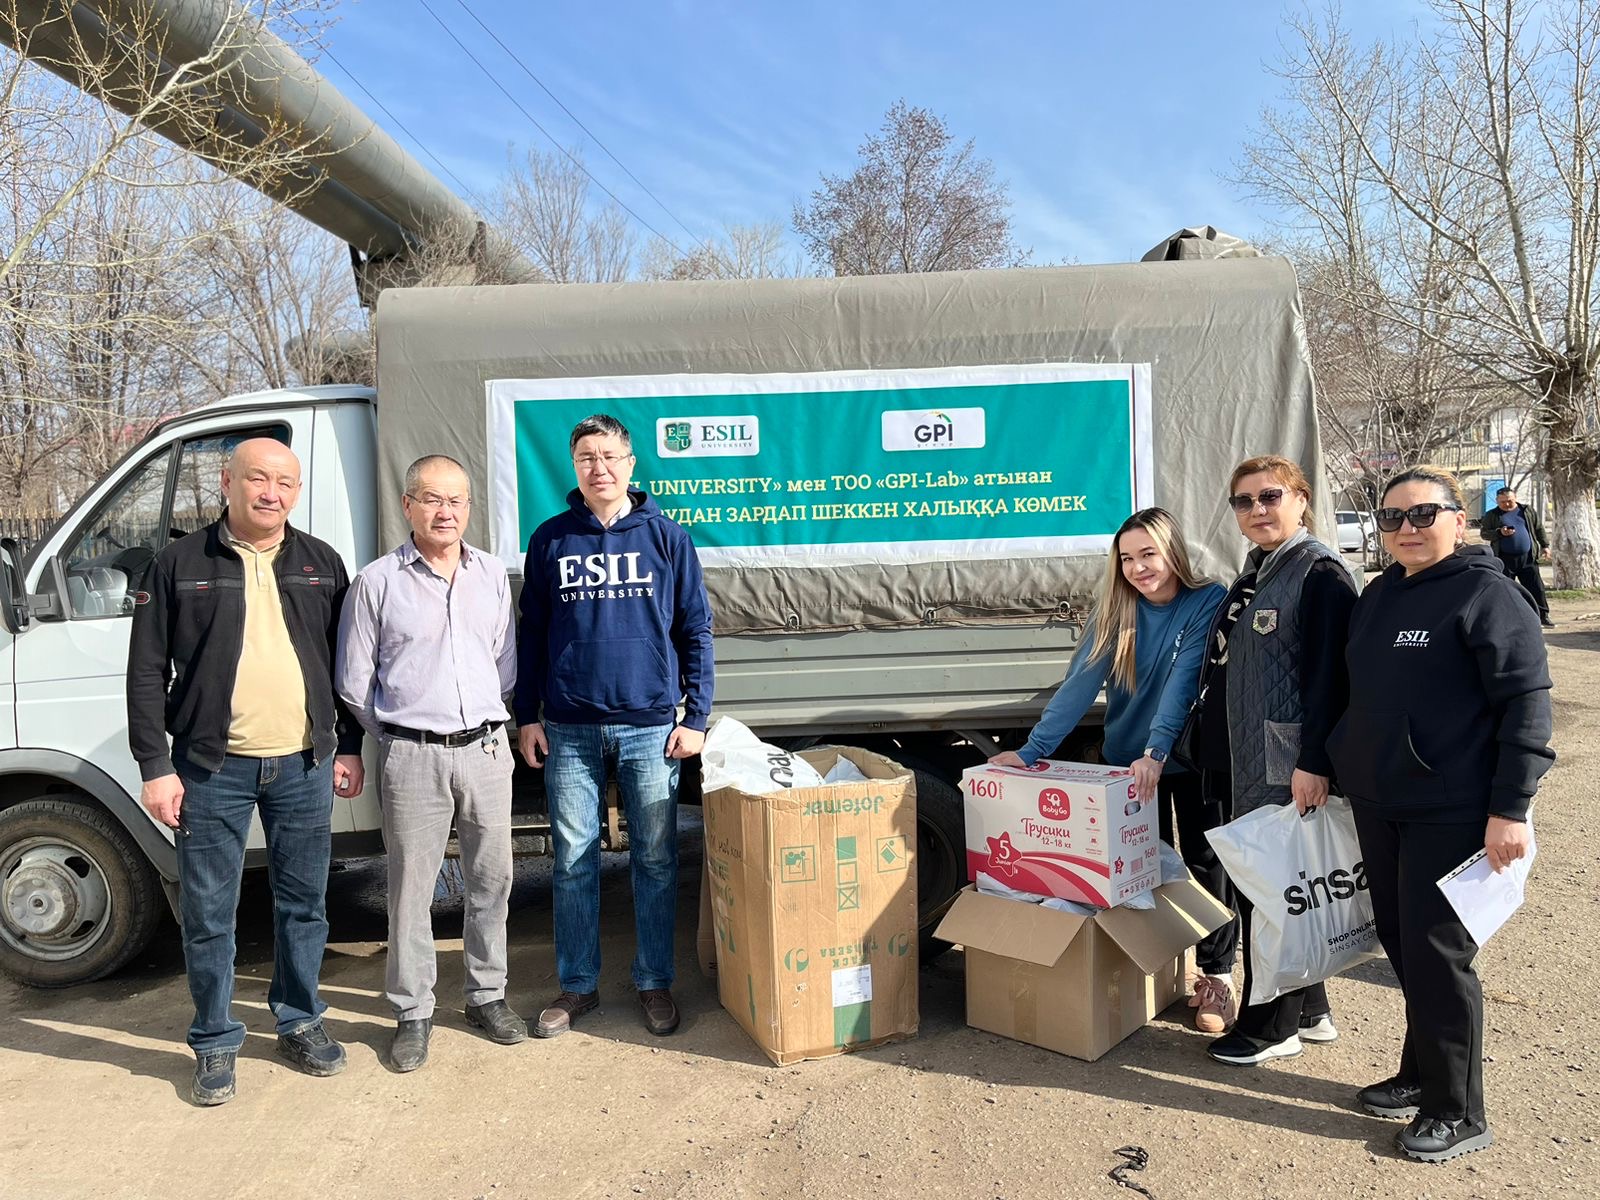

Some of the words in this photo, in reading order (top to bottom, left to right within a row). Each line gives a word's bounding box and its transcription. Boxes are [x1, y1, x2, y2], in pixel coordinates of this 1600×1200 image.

[701, 424, 752, 441] ESIL
[914, 424, 953, 443] GPI
[650, 478, 782, 496] UNIVERSITY»
[787, 478, 827, 492] мен
[831, 474, 872, 490] ТОО
[876, 471, 969, 489] «GPI-Lab»
[973, 471, 1053, 486] атынан
[660, 507, 722, 527] УДАН
[726, 504, 807, 525] ЗАРДАП
[812, 502, 899, 521] ШЕККЕН
[903, 498, 1009, 518] ХАЛЫҚҚА
[1013, 495, 1088, 513] КӨМЕК
[557, 552, 653, 589] ESIL
[561, 588, 654, 602] UNIVERSITY
[1395, 630, 1430, 643] ESIL
[968, 778, 998, 798] 160
[803, 795, 884, 816] Jofemar
[1021, 817, 1070, 838] Трусики
[999, 840, 1010, 860] 5
[1041, 837, 1063, 848] 12-18
[1328, 932, 1350, 946] SHOP
[1351, 918, 1376, 936] ONLINE
